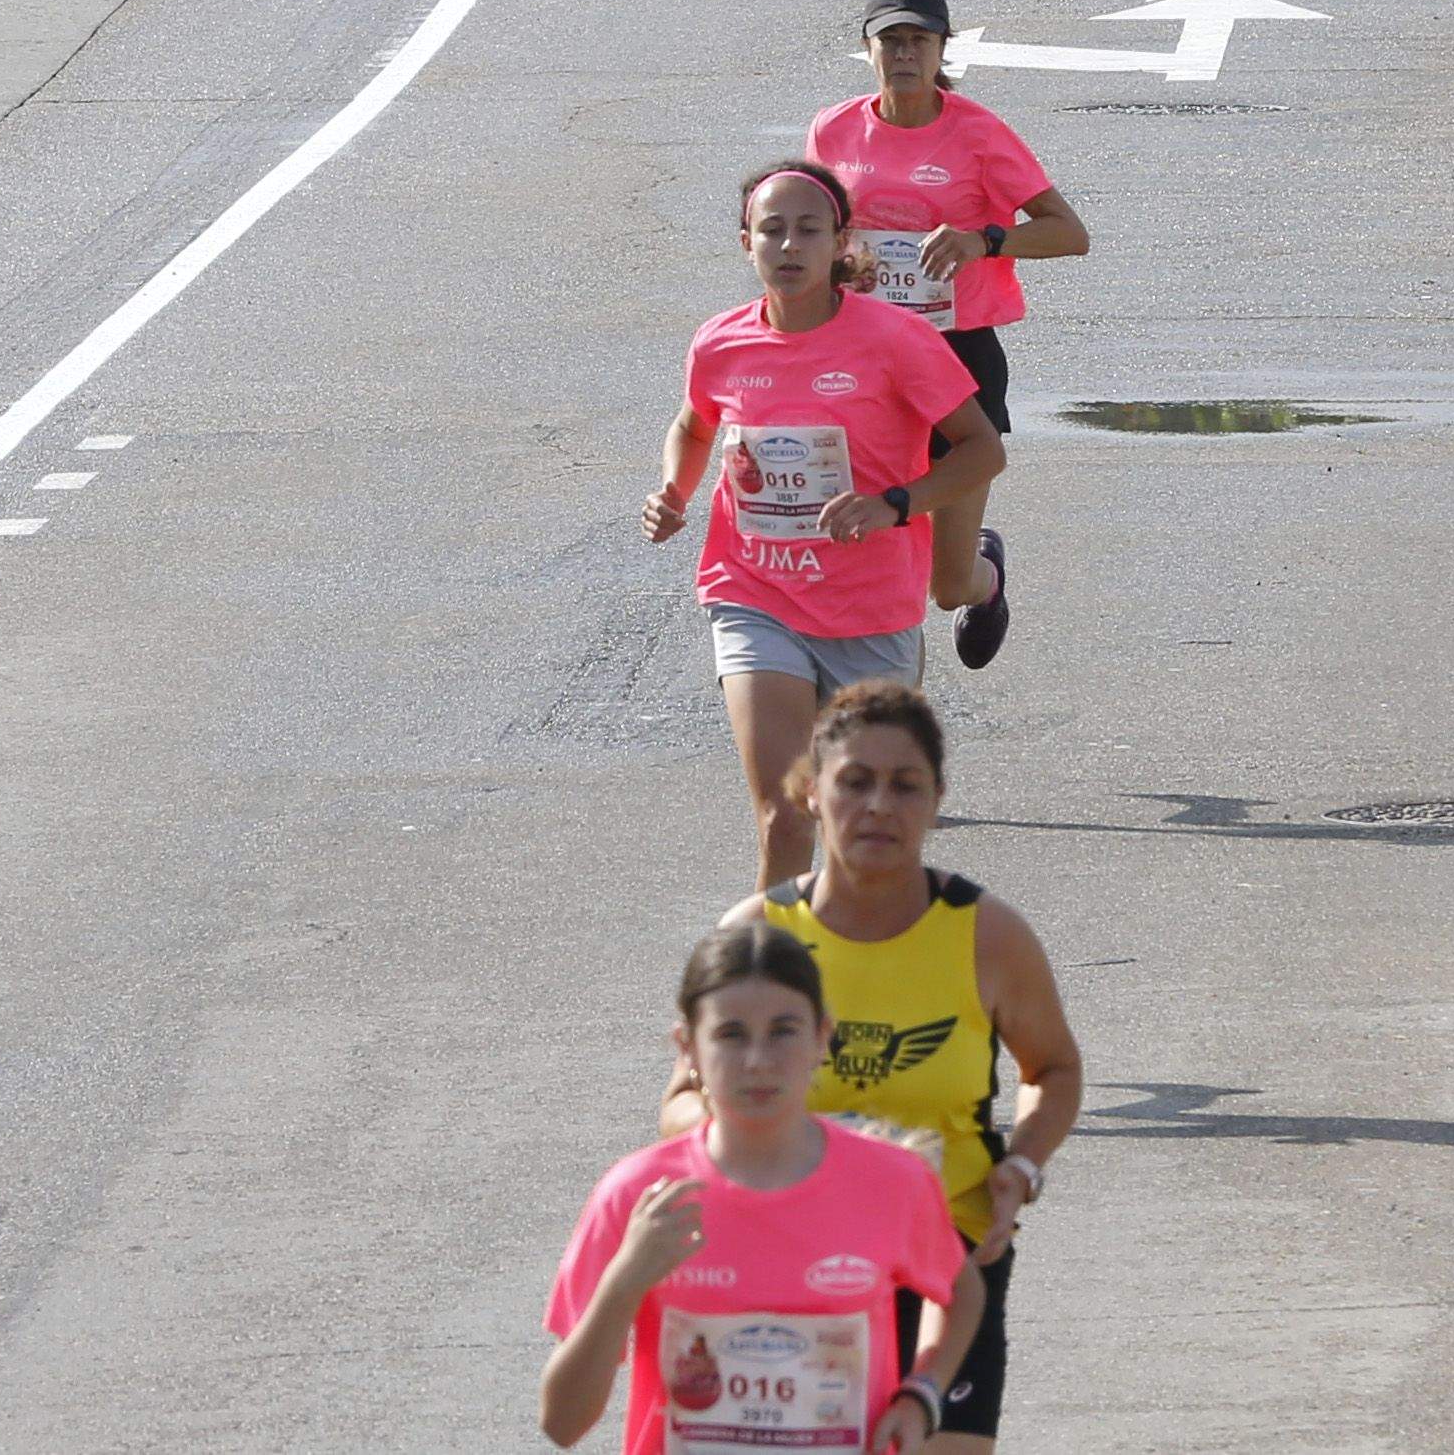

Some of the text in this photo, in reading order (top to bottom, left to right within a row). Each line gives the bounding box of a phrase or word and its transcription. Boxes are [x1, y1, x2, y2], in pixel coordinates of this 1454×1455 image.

[880, 271, 915, 287] 016
[766, 471, 807, 488] 016
[728, 1373, 796, 1403] 016
